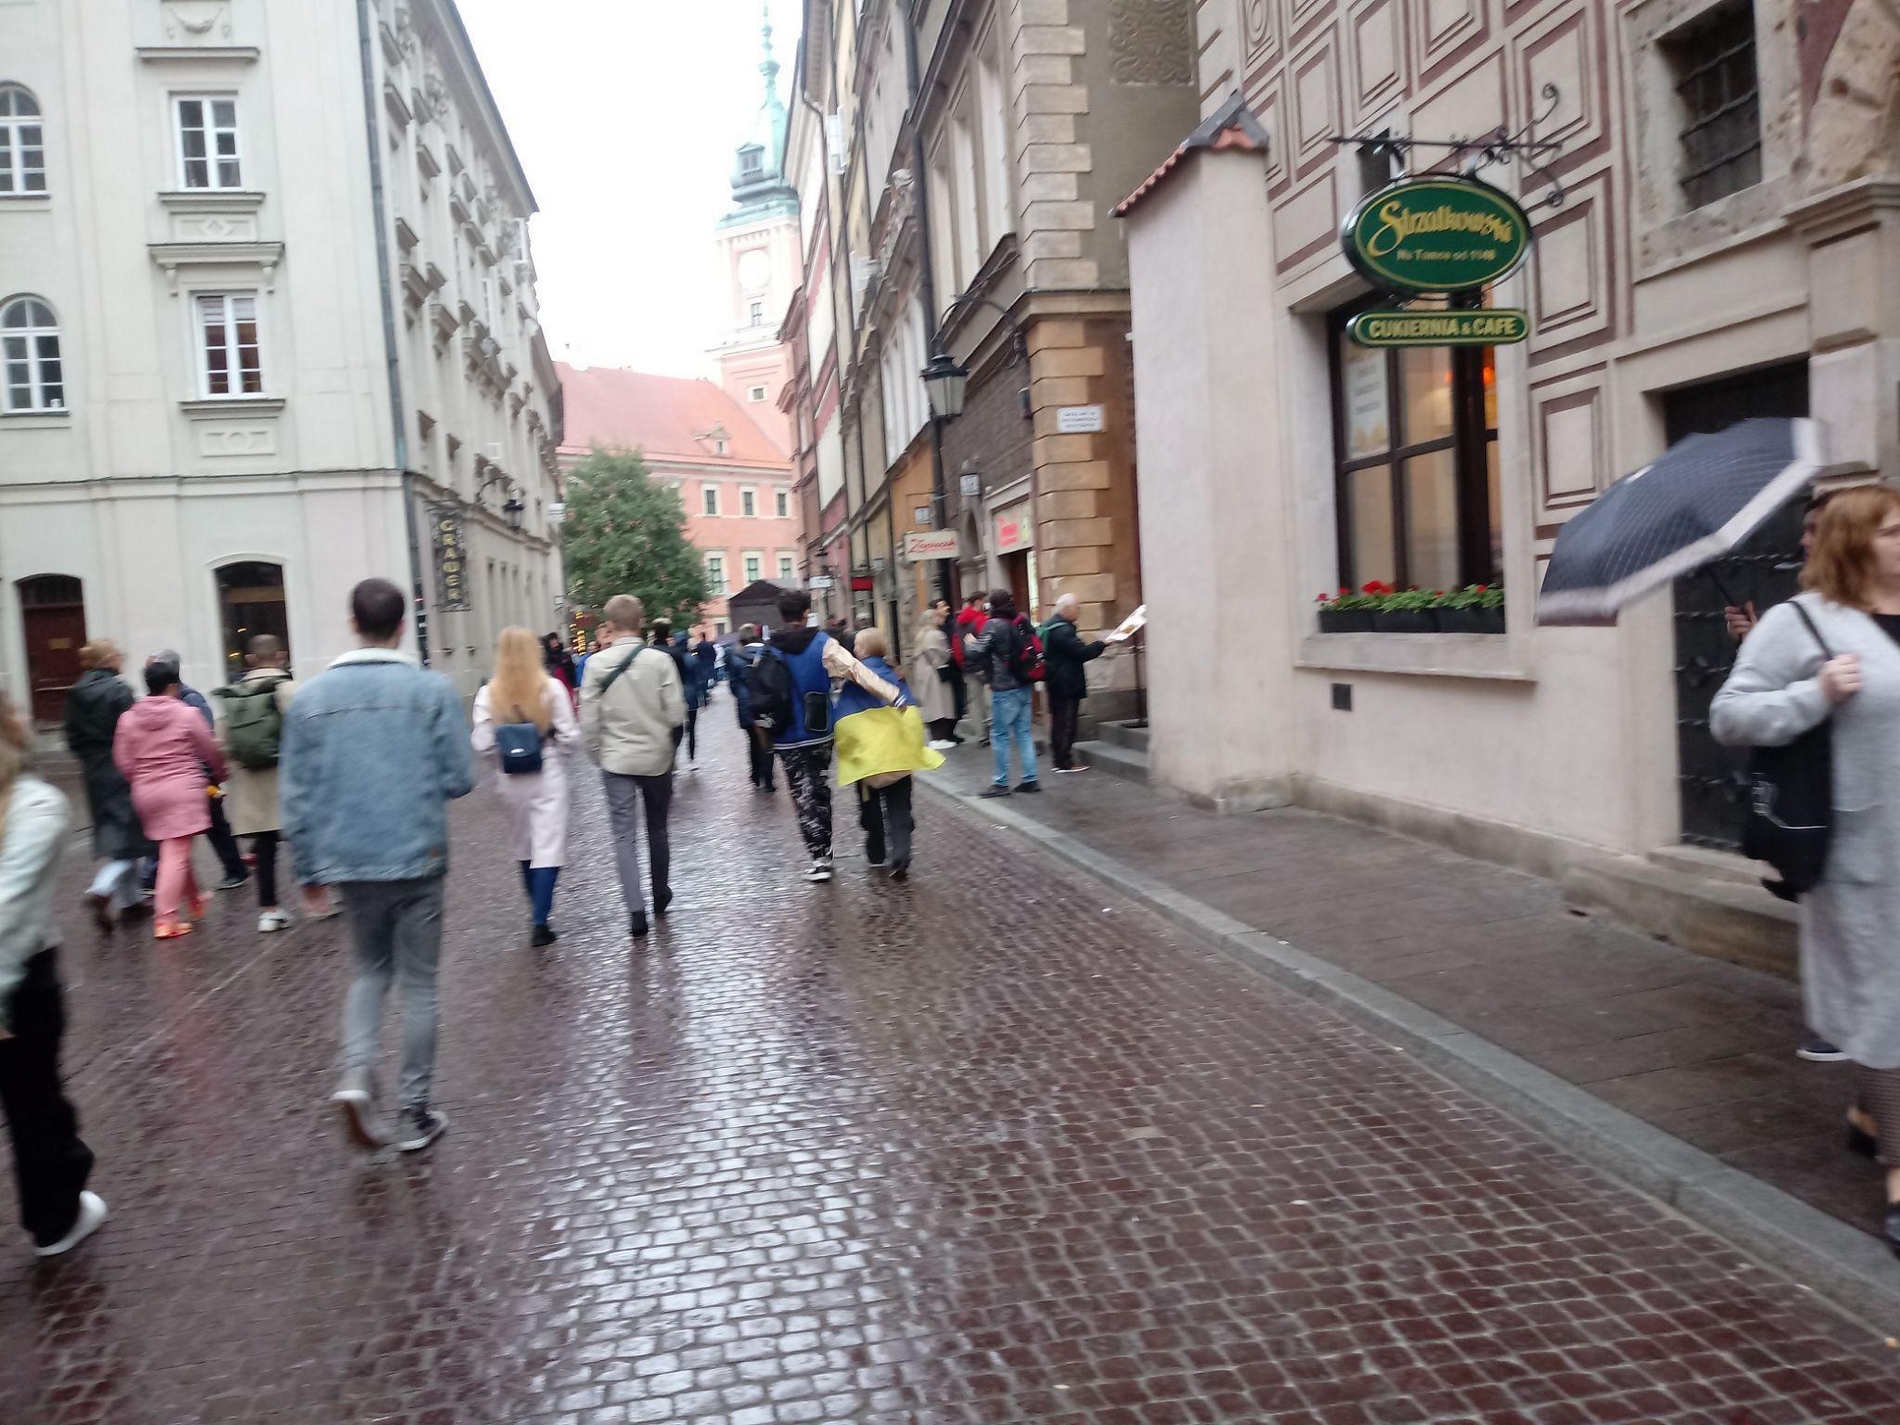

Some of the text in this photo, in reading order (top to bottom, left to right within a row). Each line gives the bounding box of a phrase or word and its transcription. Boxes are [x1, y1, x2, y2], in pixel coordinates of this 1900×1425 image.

[1369, 317, 1518, 338] CUKIERNIA & CAFE
